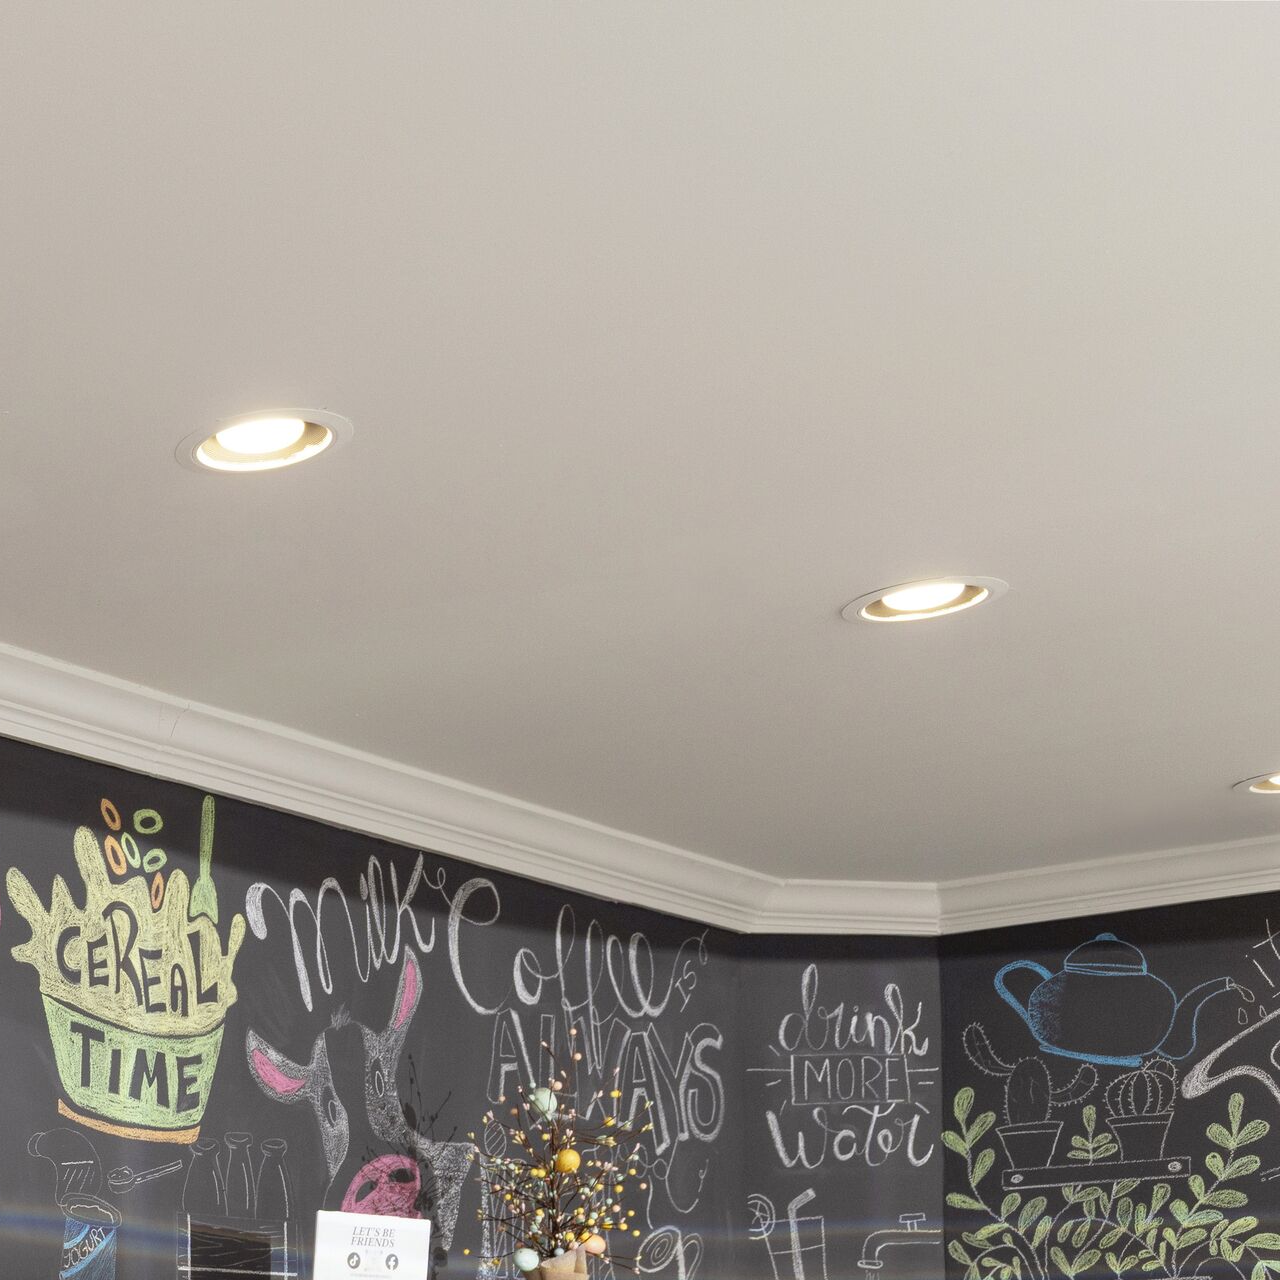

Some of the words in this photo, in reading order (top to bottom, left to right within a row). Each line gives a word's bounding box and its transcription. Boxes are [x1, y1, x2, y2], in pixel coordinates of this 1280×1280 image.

[56, 901, 218, 1017] CEREAL
[779, 964, 929, 1057] drink
[70, 1021, 203, 1114] TIME
[804, 1058, 902, 1100] MORE
[63, 1225, 107, 1269] YOGURT
[350, 1236, 395, 1248] FRIENDS
[352, 1226, 380, 1238] LET'S
[382, 1228, 397, 1239] BE
